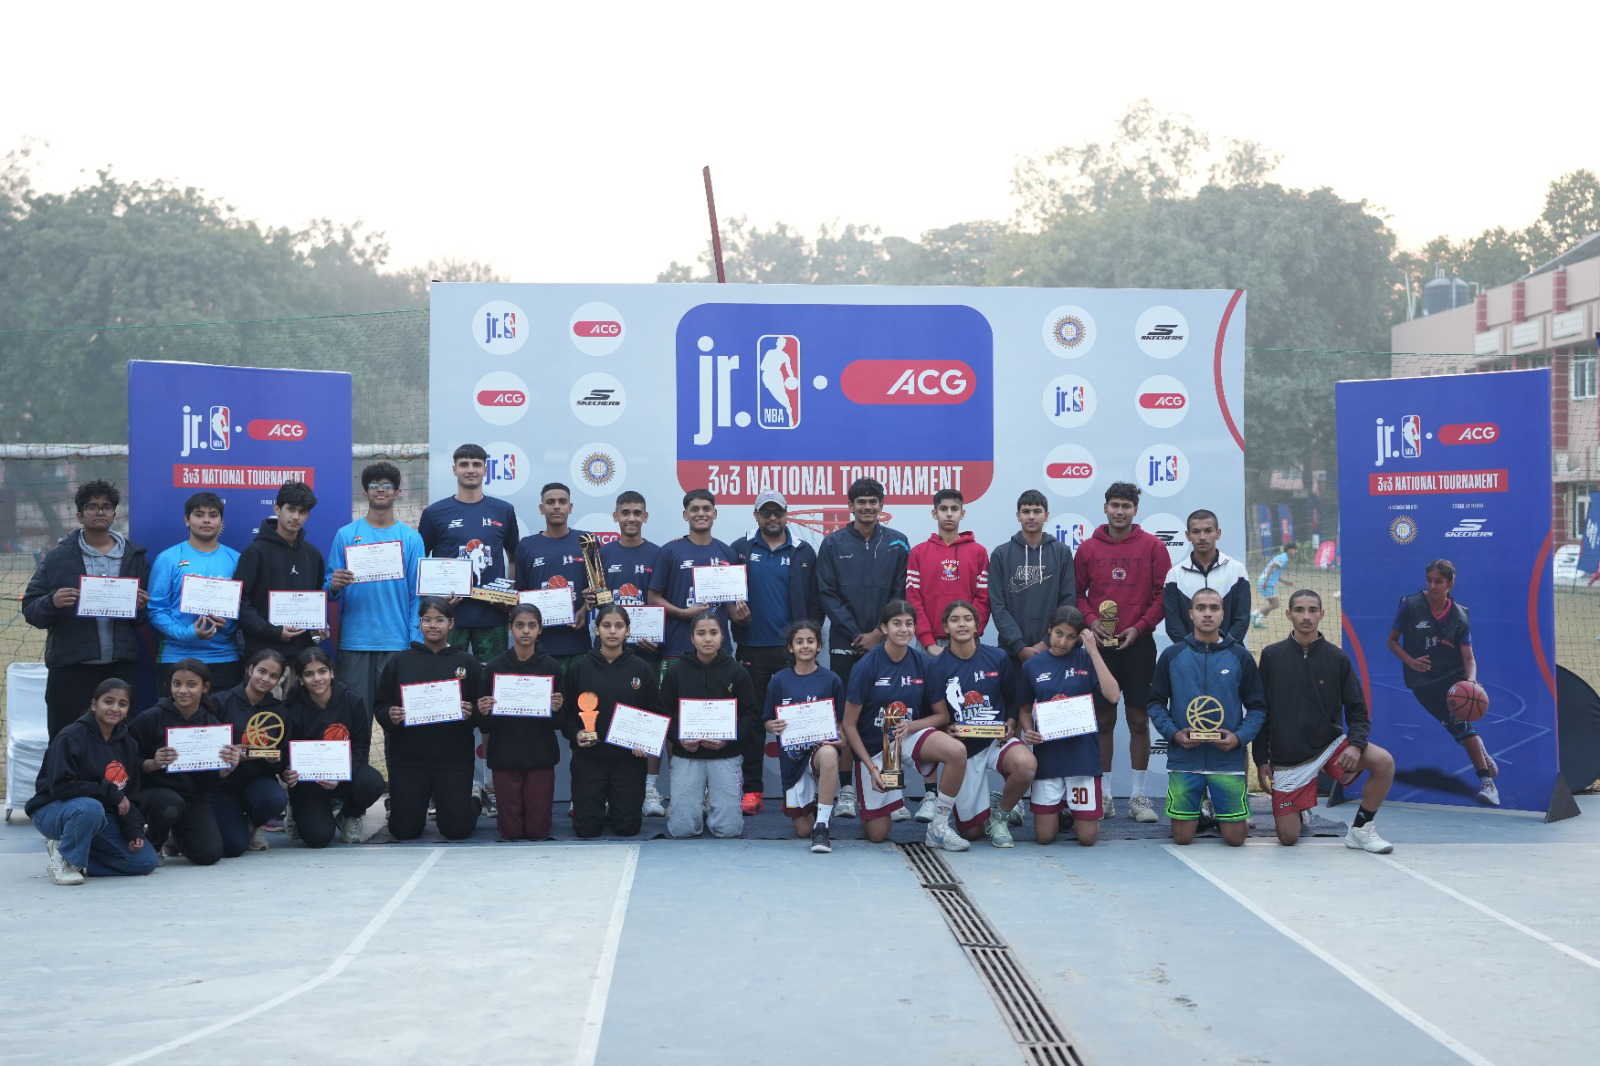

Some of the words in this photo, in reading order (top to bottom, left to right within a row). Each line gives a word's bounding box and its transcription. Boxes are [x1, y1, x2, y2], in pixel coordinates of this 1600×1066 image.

[486, 313, 502, 343] jr.
[590, 324, 619, 334] ACG
[694, 336, 751, 445] jr.
[887, 369, 967, 396] ACG
[494, 392, 523, 403] ACG
[1055, 386, 1070, 416] jr.
[1155, 396, 1182, 406] ACG
[764, 408, 784, 423] NBA
[181, 405, 208, 457] jr.
[268, 424, 304, 436] ACG
[1458, 426, 1496, 440] ACG
[1376, 418, 1400, 466] jr.
[184, 468, 200, 484] 3v3
[202, 469, 245, 485] NATIONAL
[1062, 466, 1090, 476] ACG
[1148, 456, 1164, 486] jr.
[708, 466, 740, 496] 3v3
[746, 466, 836, 496] NATIONAL
[1378, 477, 1393, 492] 3v3
[1394, 475, 1437, 491] NATIONAL
[1439, 473, 1499, 490] TOURNAMENT
[1072, 788, 1088, 804] 30
